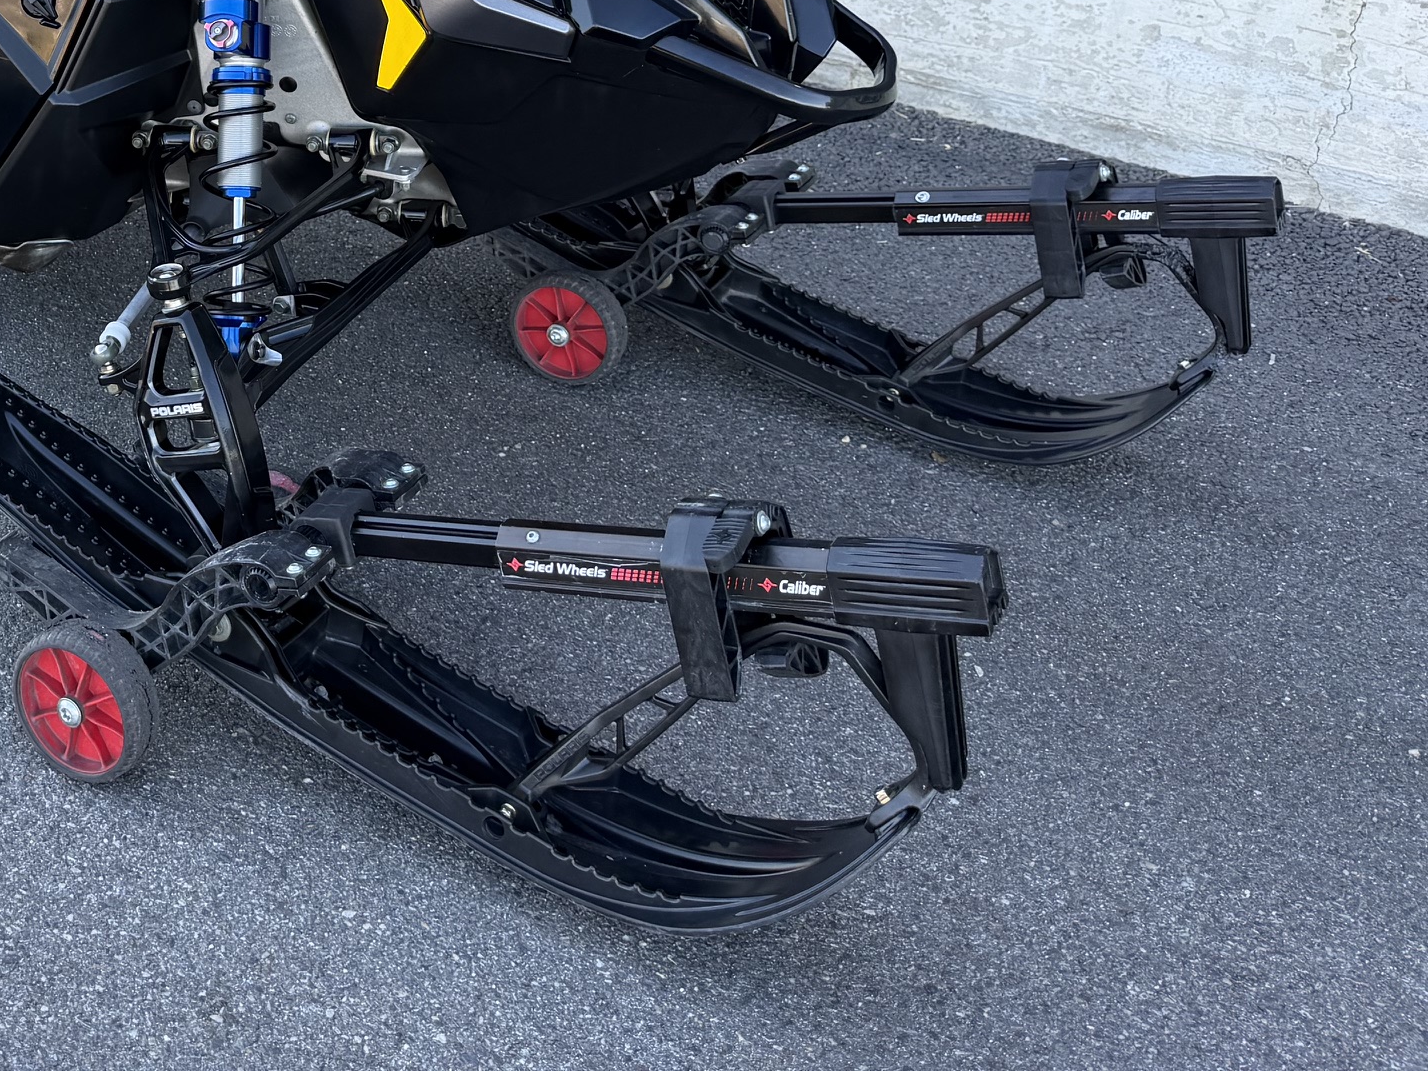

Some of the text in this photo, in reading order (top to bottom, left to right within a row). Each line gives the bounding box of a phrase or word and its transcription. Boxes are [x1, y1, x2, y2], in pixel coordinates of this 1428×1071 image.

[916, 212, 983, 223] Sled Wheels
[1117, 209, 1153, 221] Caliber
[150, 402, 204, 417] POLARIS
[524, 559, 607, 579] Sled Wheels
[778, 579, 823, 596] Caliber
